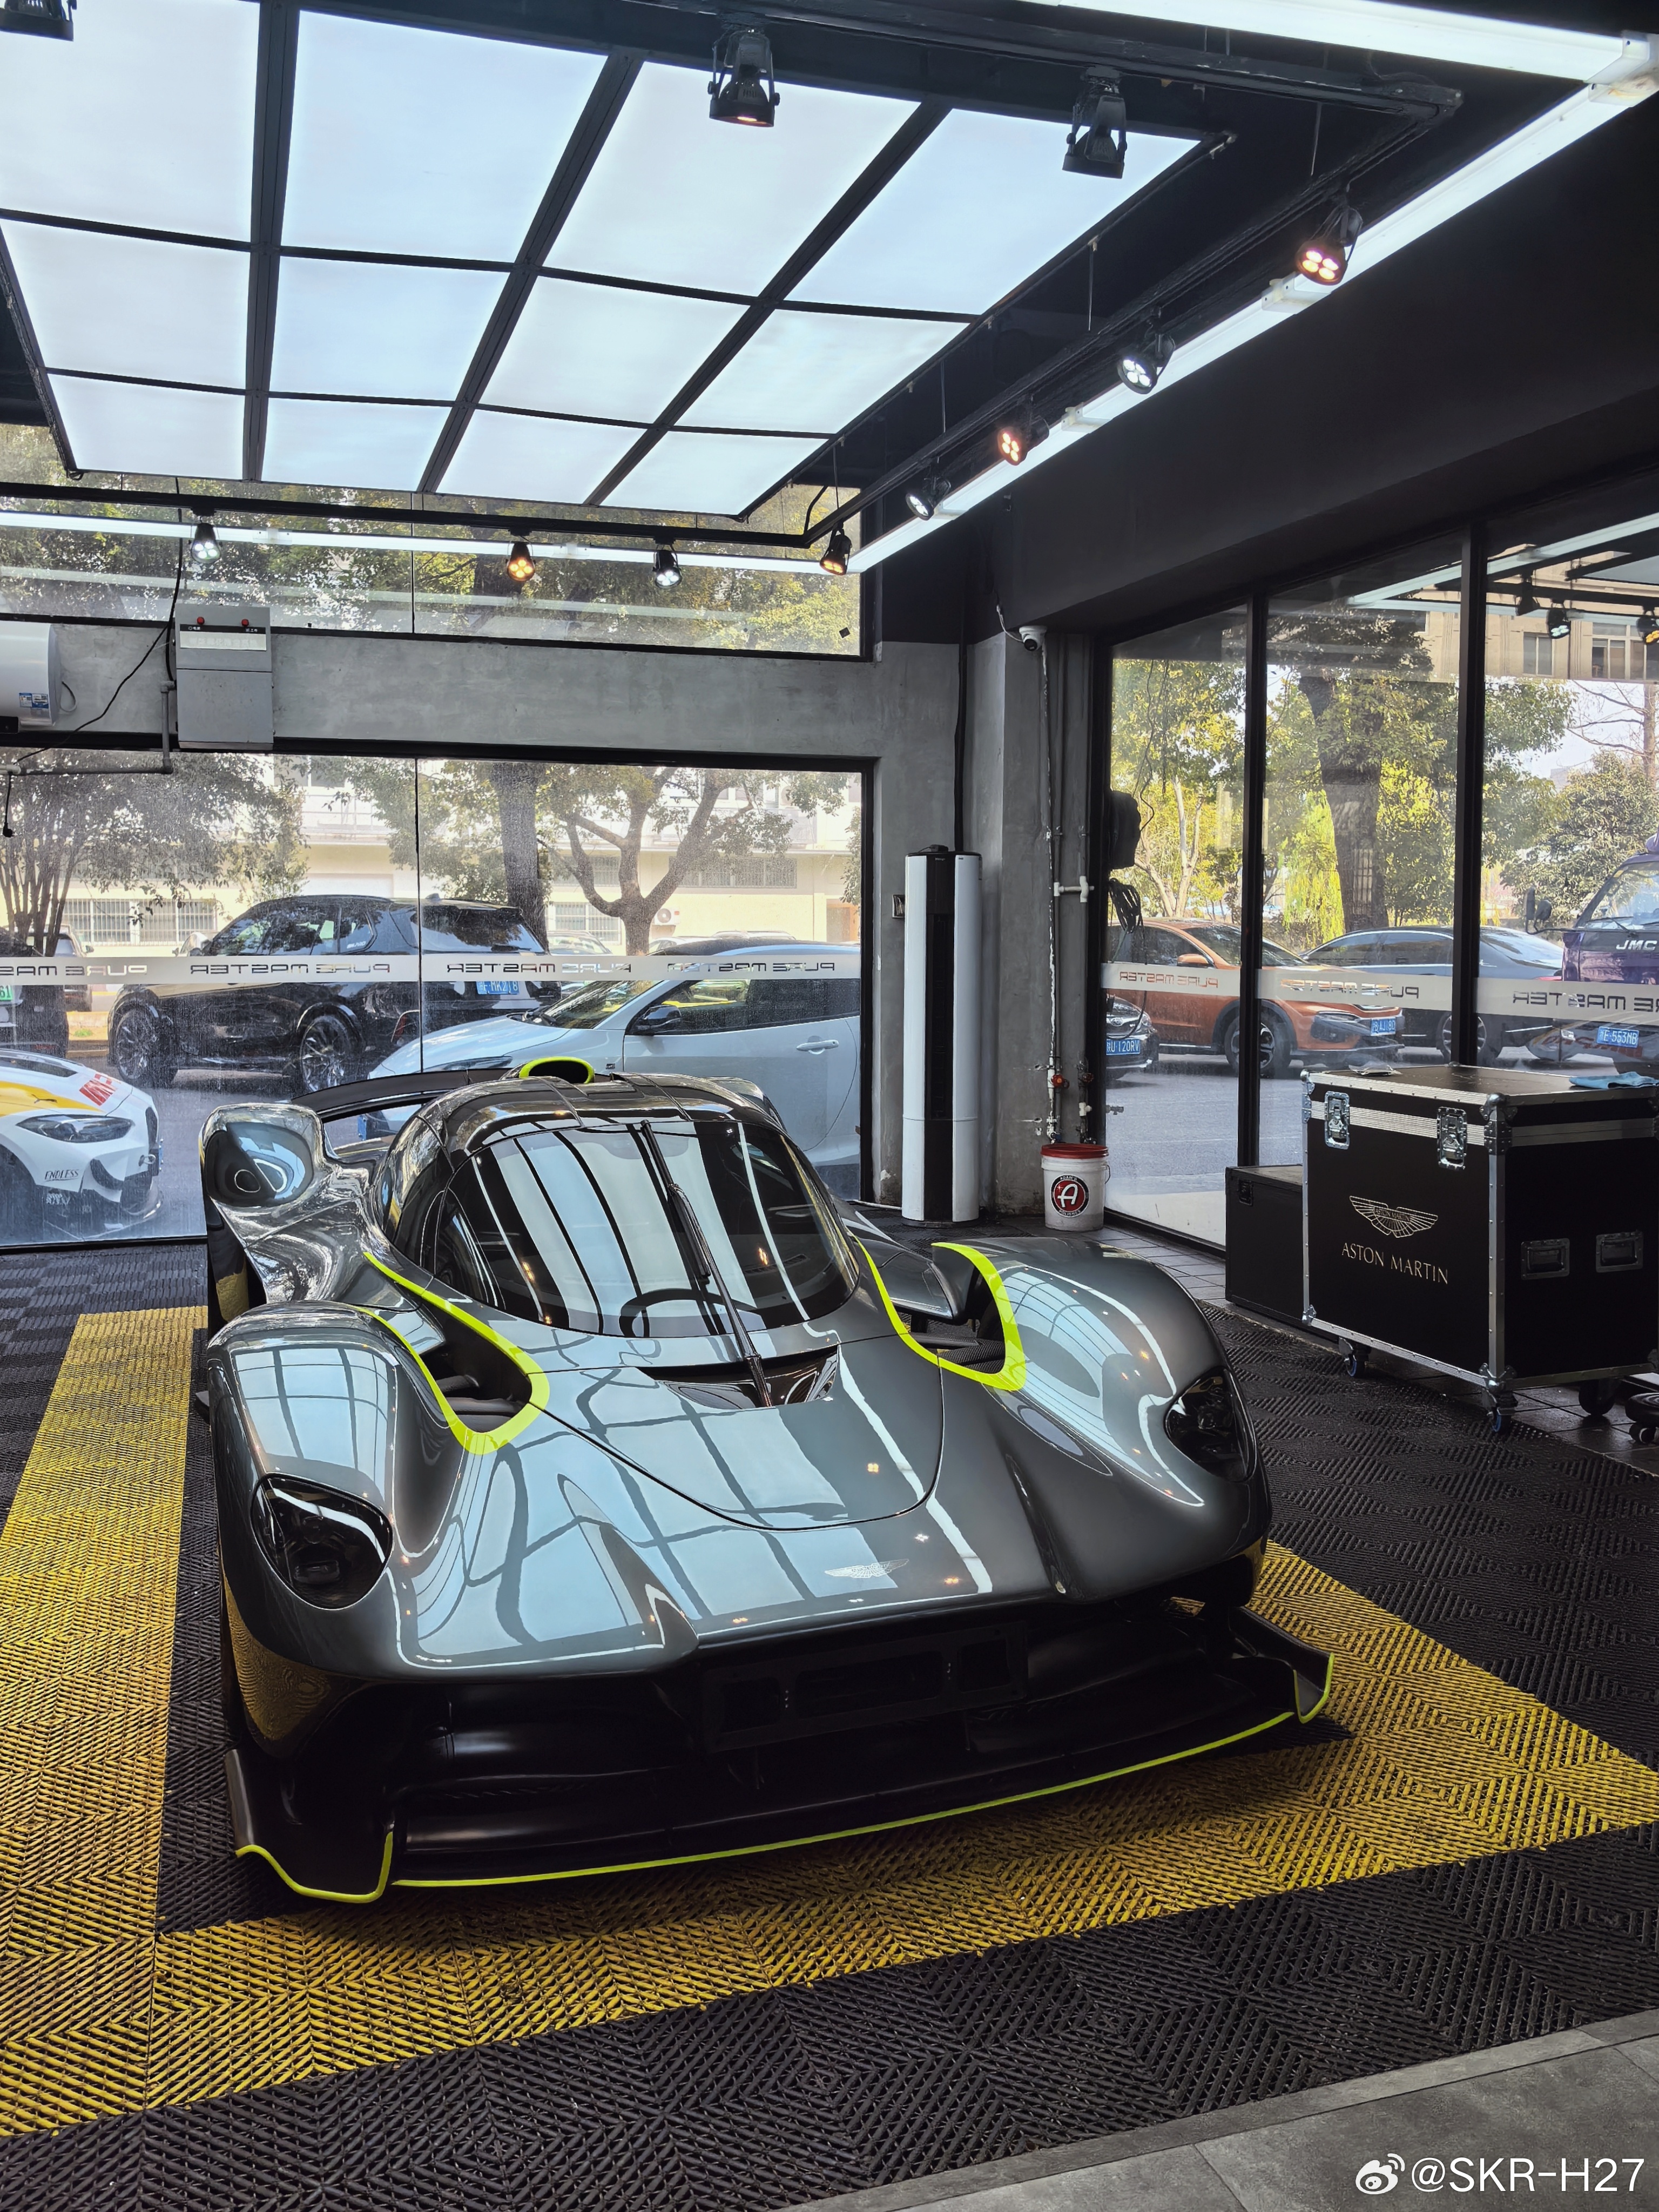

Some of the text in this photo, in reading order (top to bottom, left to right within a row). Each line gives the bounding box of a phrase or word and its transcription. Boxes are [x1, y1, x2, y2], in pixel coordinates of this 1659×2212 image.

[1616, 940, 1657, 950] JMC
[45, 1169, 79, 1181] ENDLESS
[1342, 1242, 1448, 1285] ASTON MARTIN
